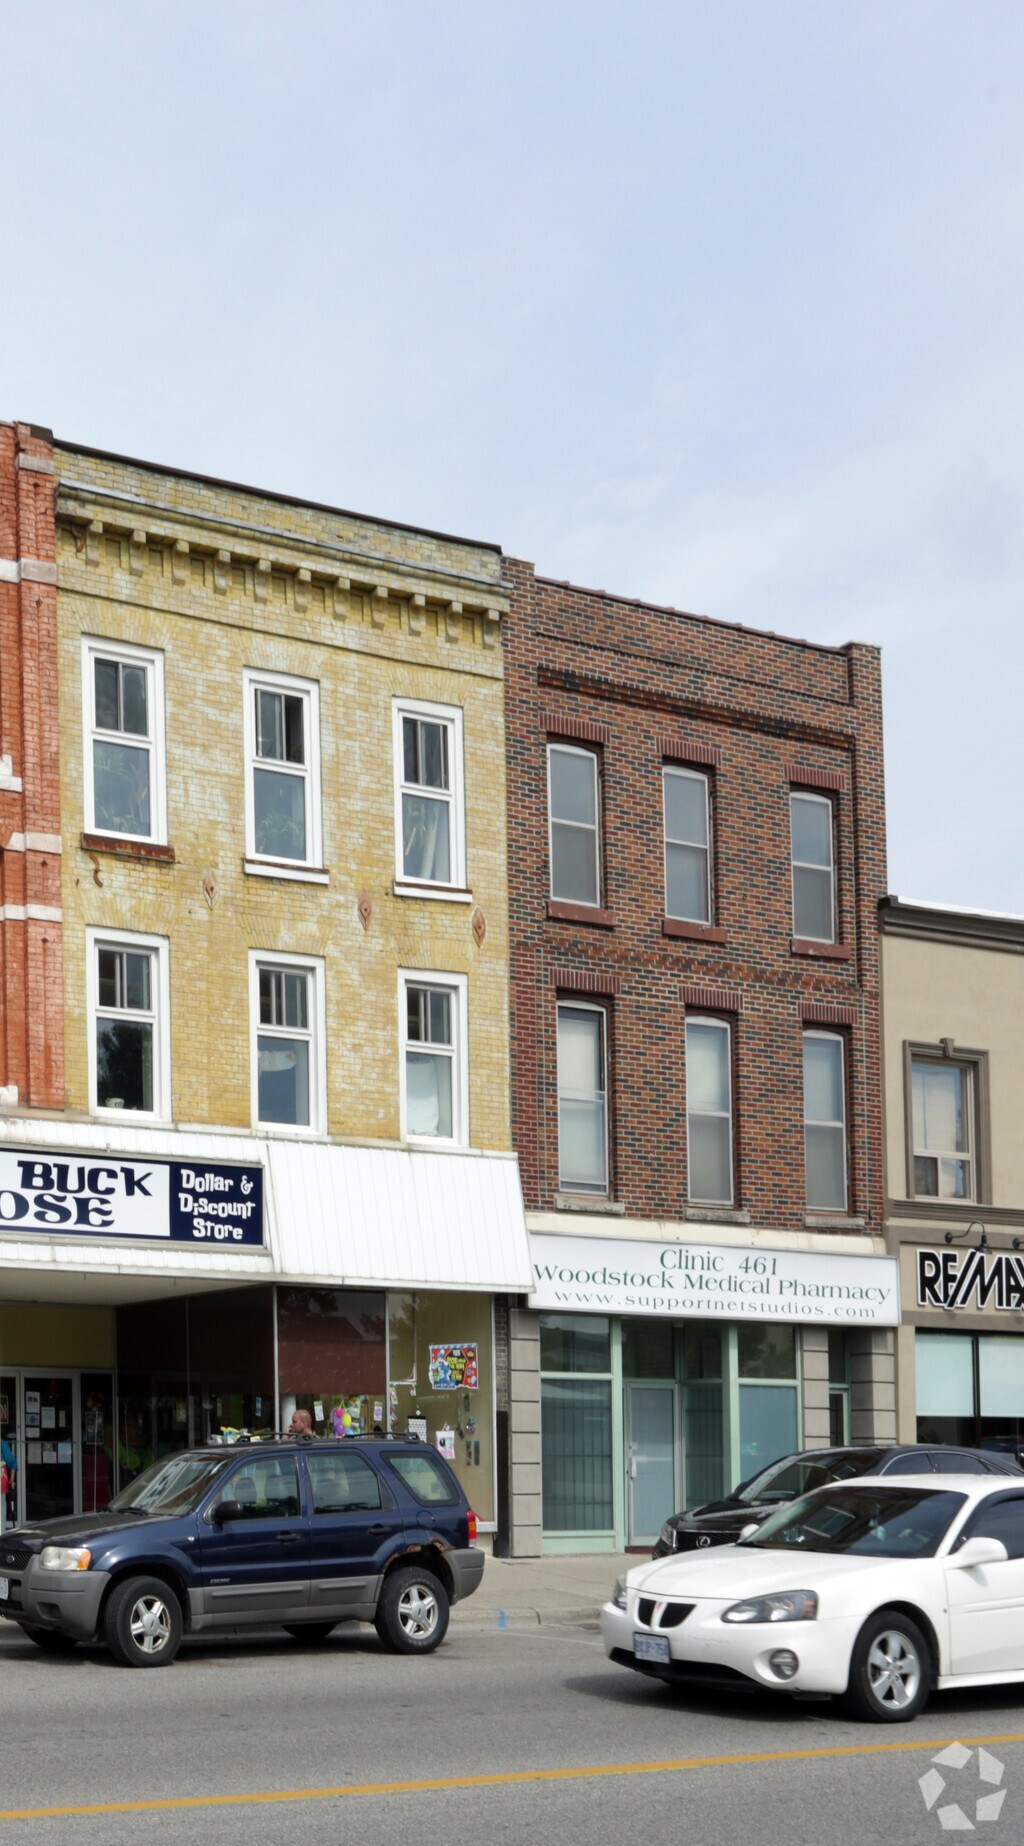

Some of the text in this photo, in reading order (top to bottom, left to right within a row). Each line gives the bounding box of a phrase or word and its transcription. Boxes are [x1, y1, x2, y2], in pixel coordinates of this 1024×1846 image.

[17, 1160, 153, 1196] BUCK
[180, 1168, 253, 1195] Dollar &
[178, 1192, 256, 1219] Discount
[192, 1218, 243, 1240] Store
[659, 1249, 777, 1276] Clinic 461
[534, 1264, 891, 1304] Woodstock Medical Pharmacy
[554, 1291, 876, 1319] www.supportnetstudios.com
